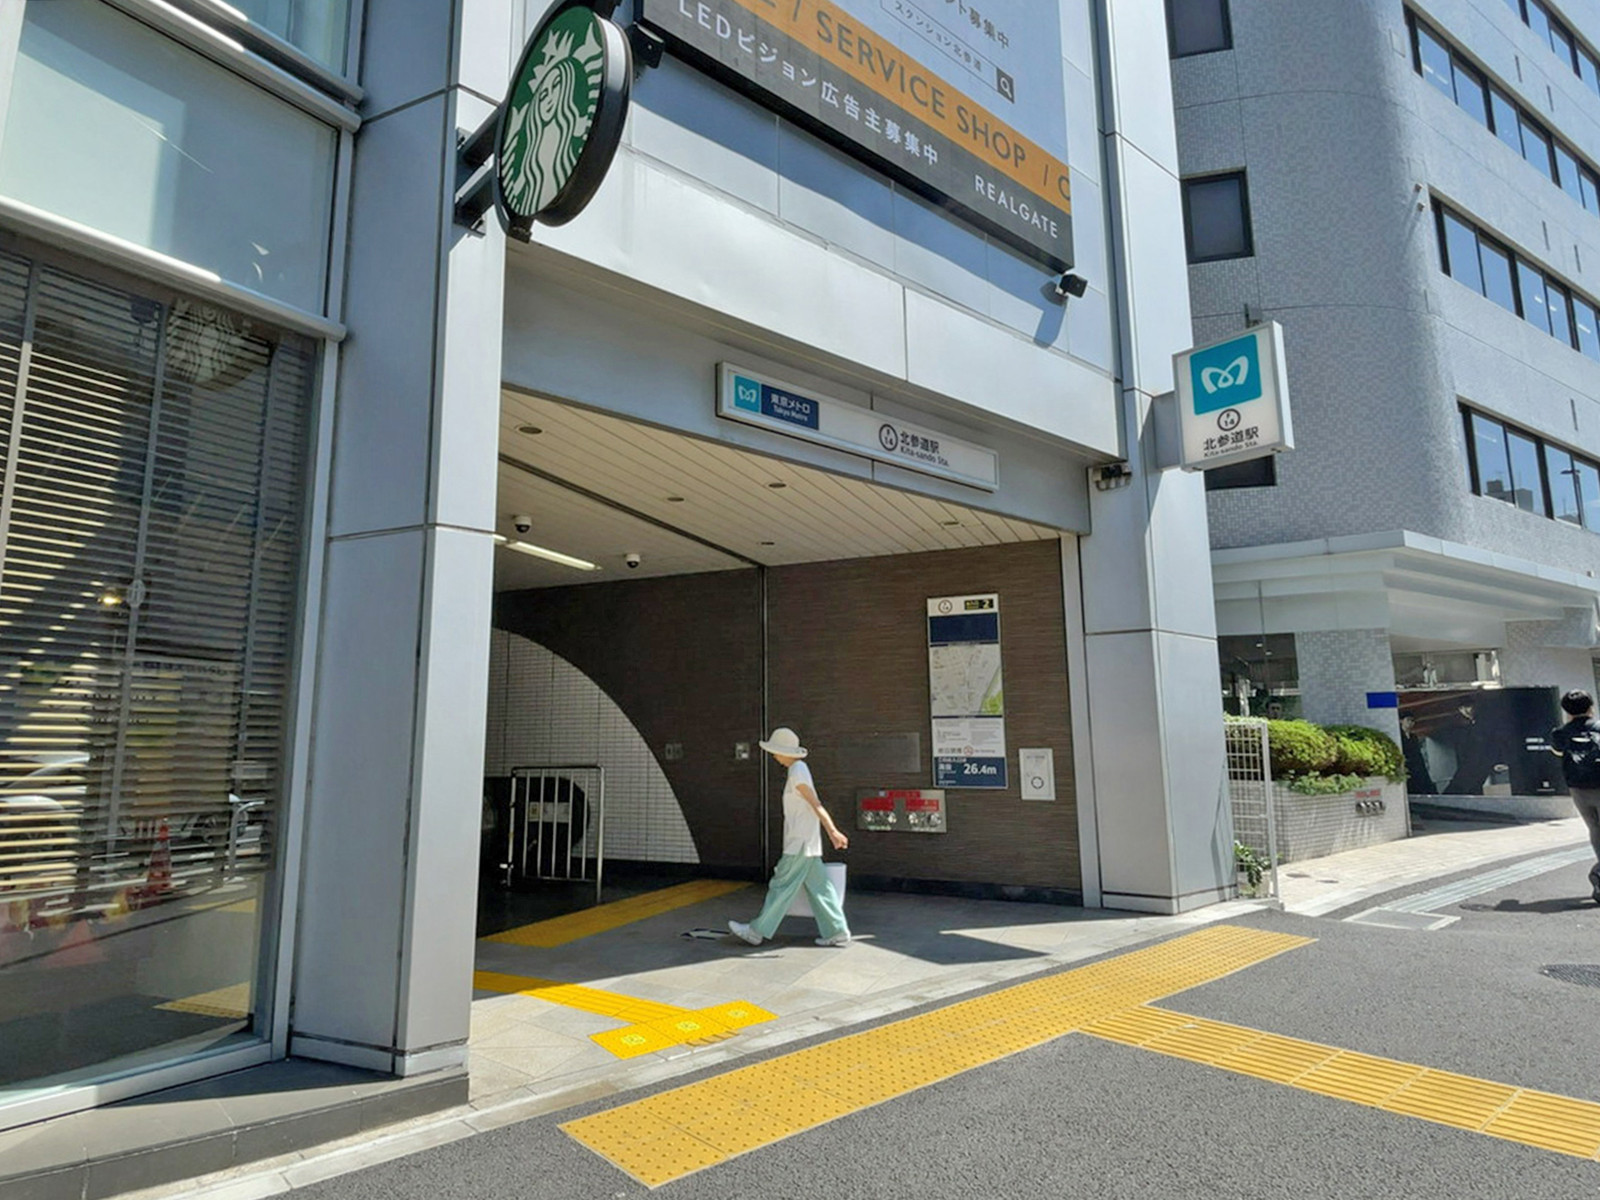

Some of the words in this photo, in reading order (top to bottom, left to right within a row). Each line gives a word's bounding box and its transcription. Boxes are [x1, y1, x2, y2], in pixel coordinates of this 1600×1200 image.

[945, 0, 1009, 48] ト募集中
[679, 0, 938, 165] LEDビジョン広告主募集中
[816, 10, 945, 119] SERVICE
[957, 104, 1026, 168] SHOP
[975, 174, 1058, 239] REALGATE
[900, 431, 940, 455] 北参道駅
[1203, 426, 1259, 450] 北参道駅
[963, 762, 997, 775] 26.4m
